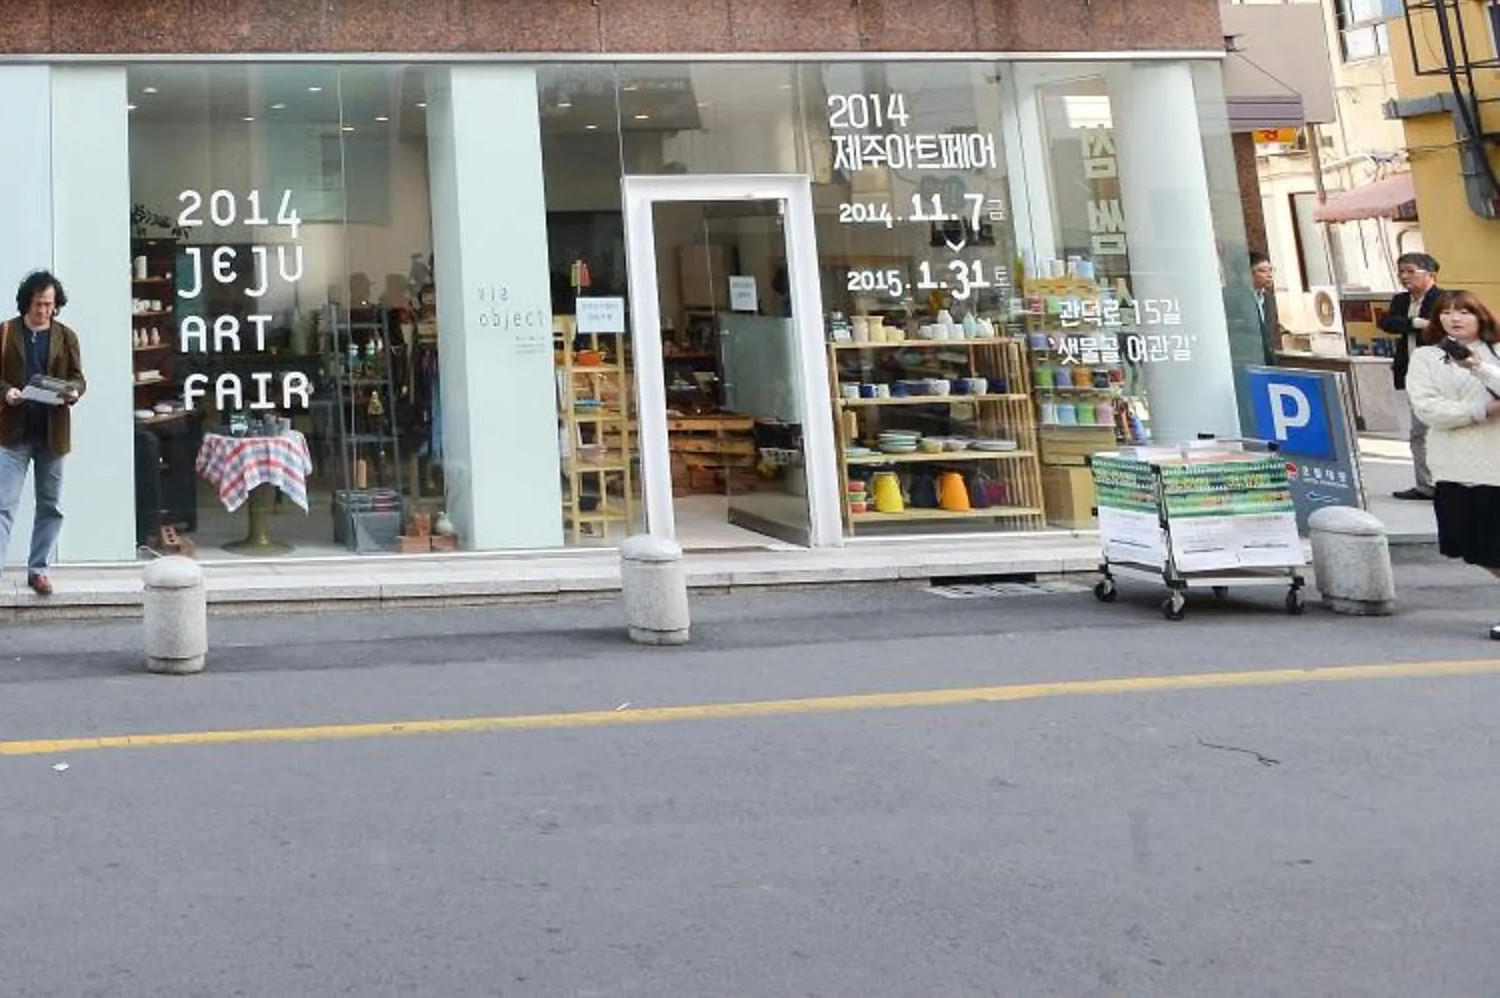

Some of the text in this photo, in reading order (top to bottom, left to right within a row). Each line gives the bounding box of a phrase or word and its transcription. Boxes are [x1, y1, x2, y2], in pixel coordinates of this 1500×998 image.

[827, 93, 910, 129] 2014
[831, 132, 998, 171] 제주아트페어
[177, 189, 302, 239] 2014
[177, 245, 304, 299] JEJU
[180, 314, 274, 353] ART
[183, 371, 310, 411] FAIR
[1267, 382, 1312, 441] P
